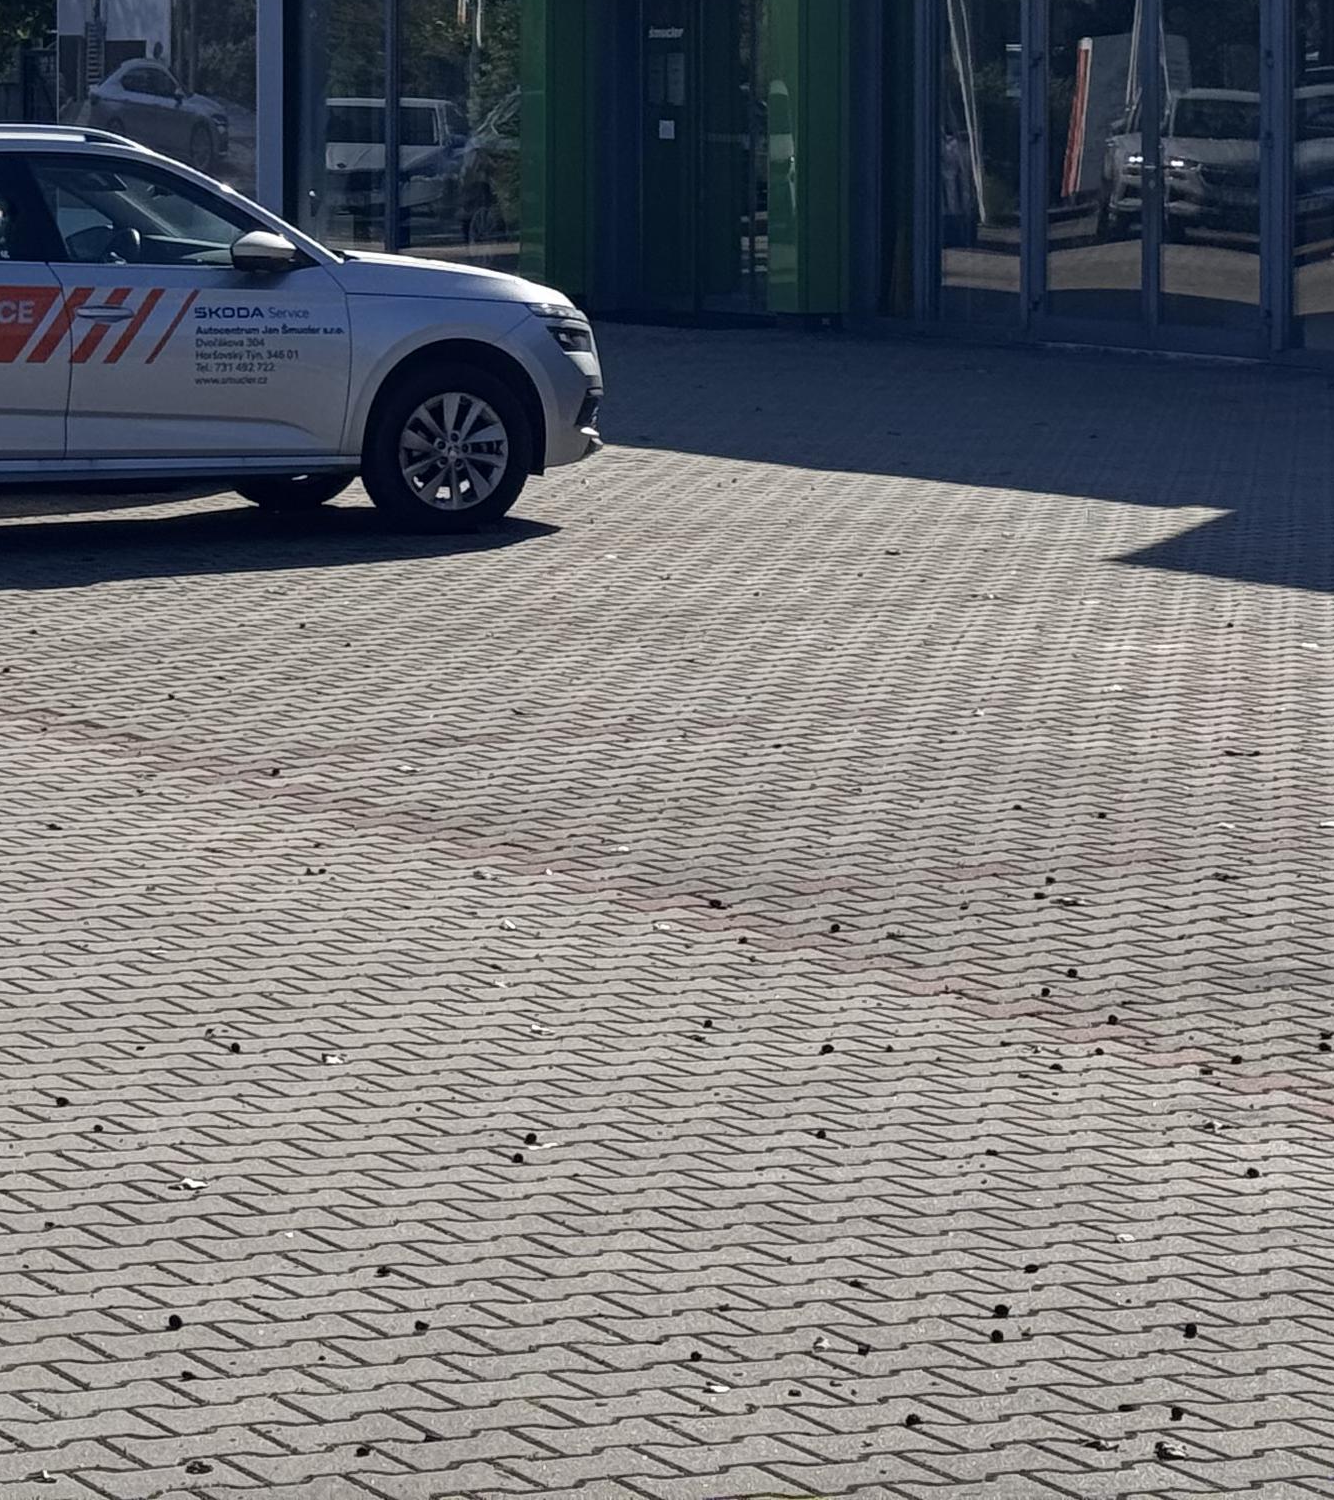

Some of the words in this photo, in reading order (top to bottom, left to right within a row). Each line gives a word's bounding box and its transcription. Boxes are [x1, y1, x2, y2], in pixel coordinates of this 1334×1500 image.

[268, 306, 310, 319] Service
[195, 325, 260, 335] Autocentrum
[262, 325, 280, 335] Jan
[281, 323, 320, 335] Šmucler
[287, 350, 299, 360] 01
